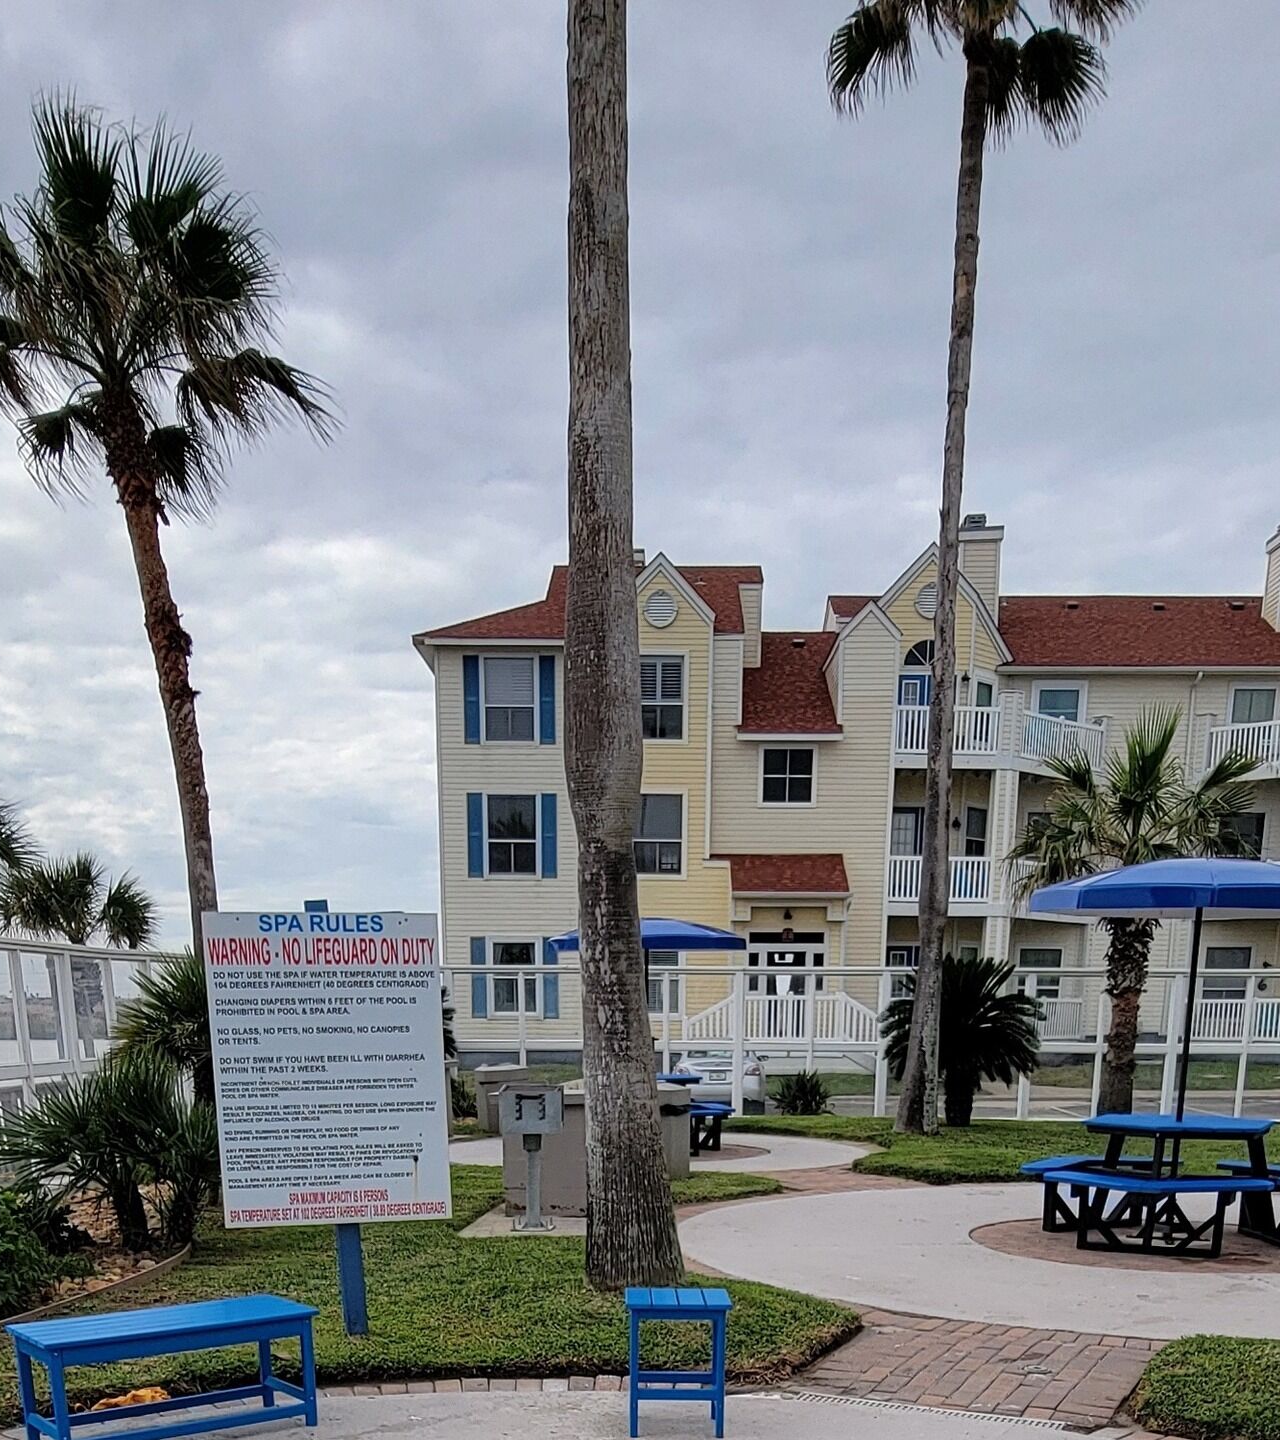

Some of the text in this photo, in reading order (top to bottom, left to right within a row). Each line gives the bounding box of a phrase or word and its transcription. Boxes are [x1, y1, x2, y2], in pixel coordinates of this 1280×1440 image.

[259, 915, 383, 932] SPA RULES
[208, 938, 271, 965] WARNING
[282, 938, 301, 965] NO
[305, 938, 377, 965] LIFEGUARD
[381, 938, 398, 965] ON
[402, 938, 434, 965] DUTY
[246, 971, 263, 979] USE
[265, 971, 281, 979] THE
[283, 971, 299, 979] SPA
[408, 970, 435, 978] ABOVE
[214, 981, 227, 989] 104
[229, 981, 269, 989] DEGREES
[376, 980, 429, 988] CENTIGRADE)
[215, 998, 259, 1006] CHANGING
[334, 997, 353, 1005] FEET
[356, 997, 366, 1005] OF
[369, 997, 384, 1005] THE
[216, 1008, 265, 1016] PROHIBITED
[326, 1007, 350, 1015] AREA.
[277, 1027, 300, 1035] PETS,
[316, 1026, 355, 1034] SMOKING,
[232, 1037, 260, 1045] TENTS.
[253, 1056, 274, 1064] SWIM
[327, 1055, 349, 1063] BEEN
[385, 1054, 425, 1062] DIARRHEA
[220, 1066, 249, 1074] WITHIN
